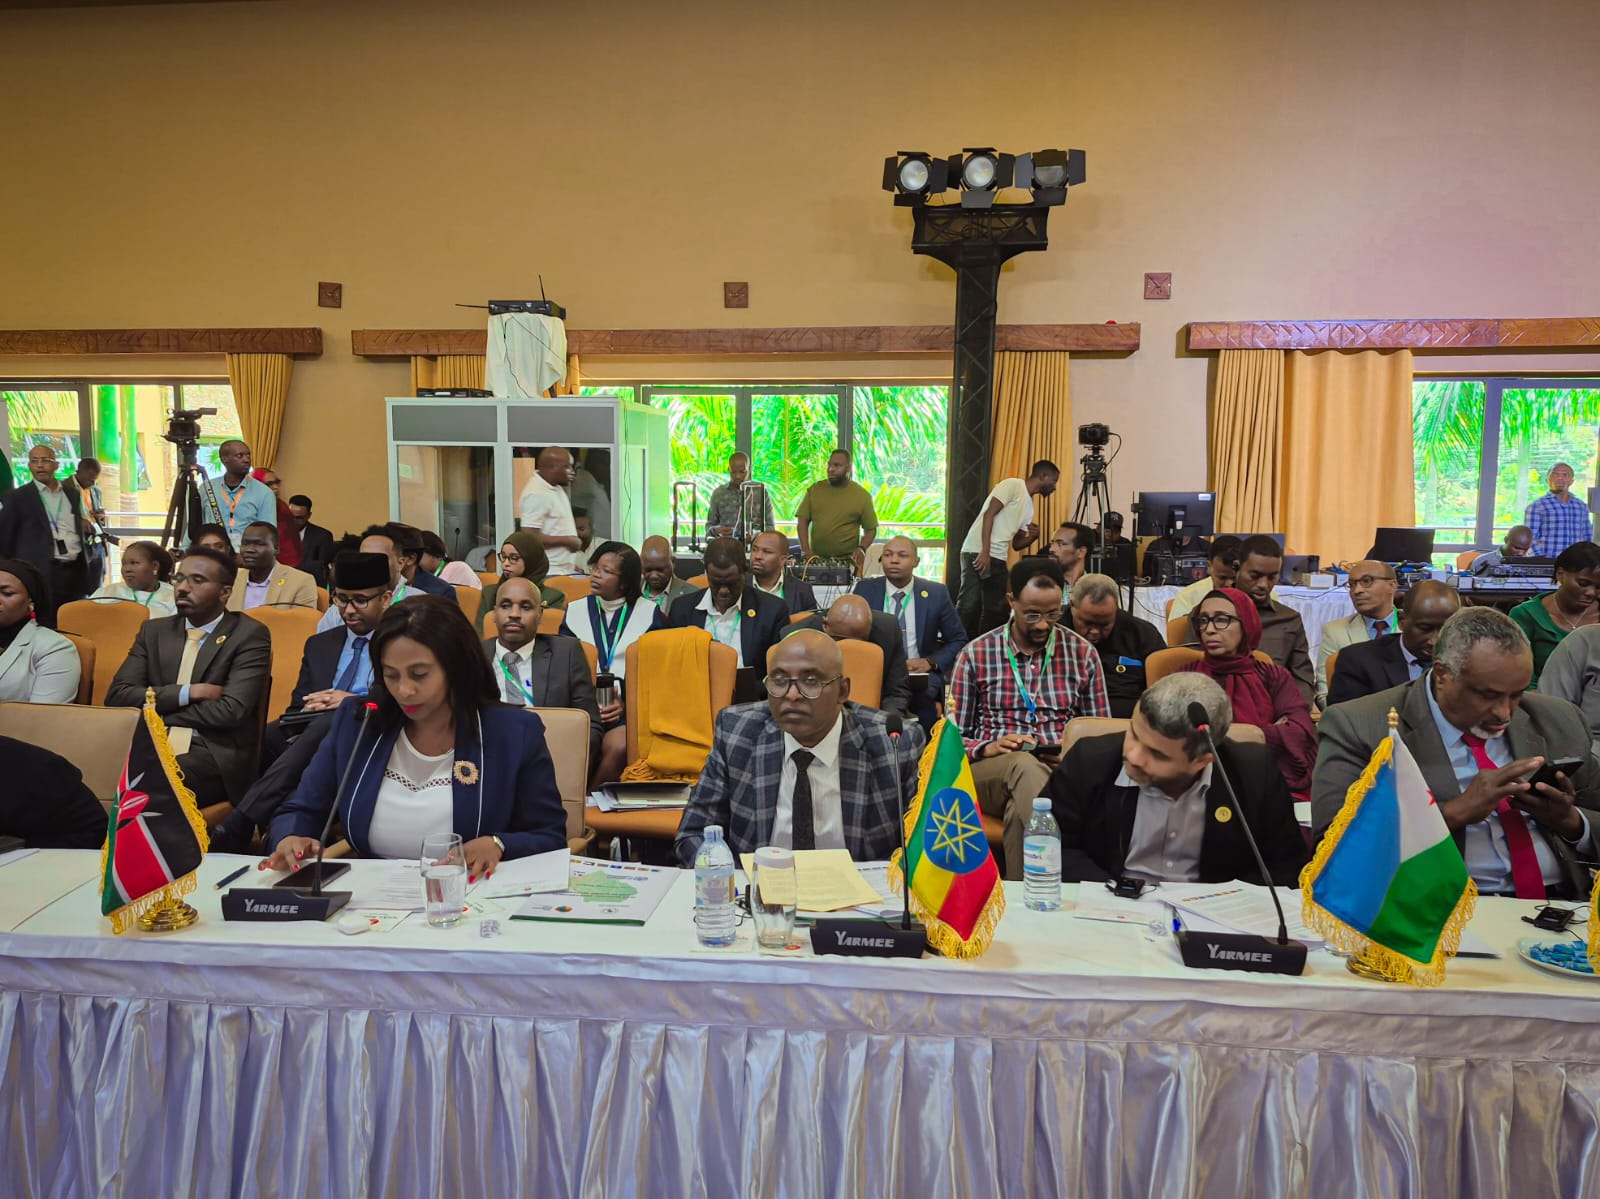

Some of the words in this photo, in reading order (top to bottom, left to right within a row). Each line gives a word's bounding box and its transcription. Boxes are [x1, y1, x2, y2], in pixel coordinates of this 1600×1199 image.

[244, 898, 299, 914] YARMEE
[835, 930, 895, 948] YARMEE
[1207, 943, 1272, 963] YARMEE
